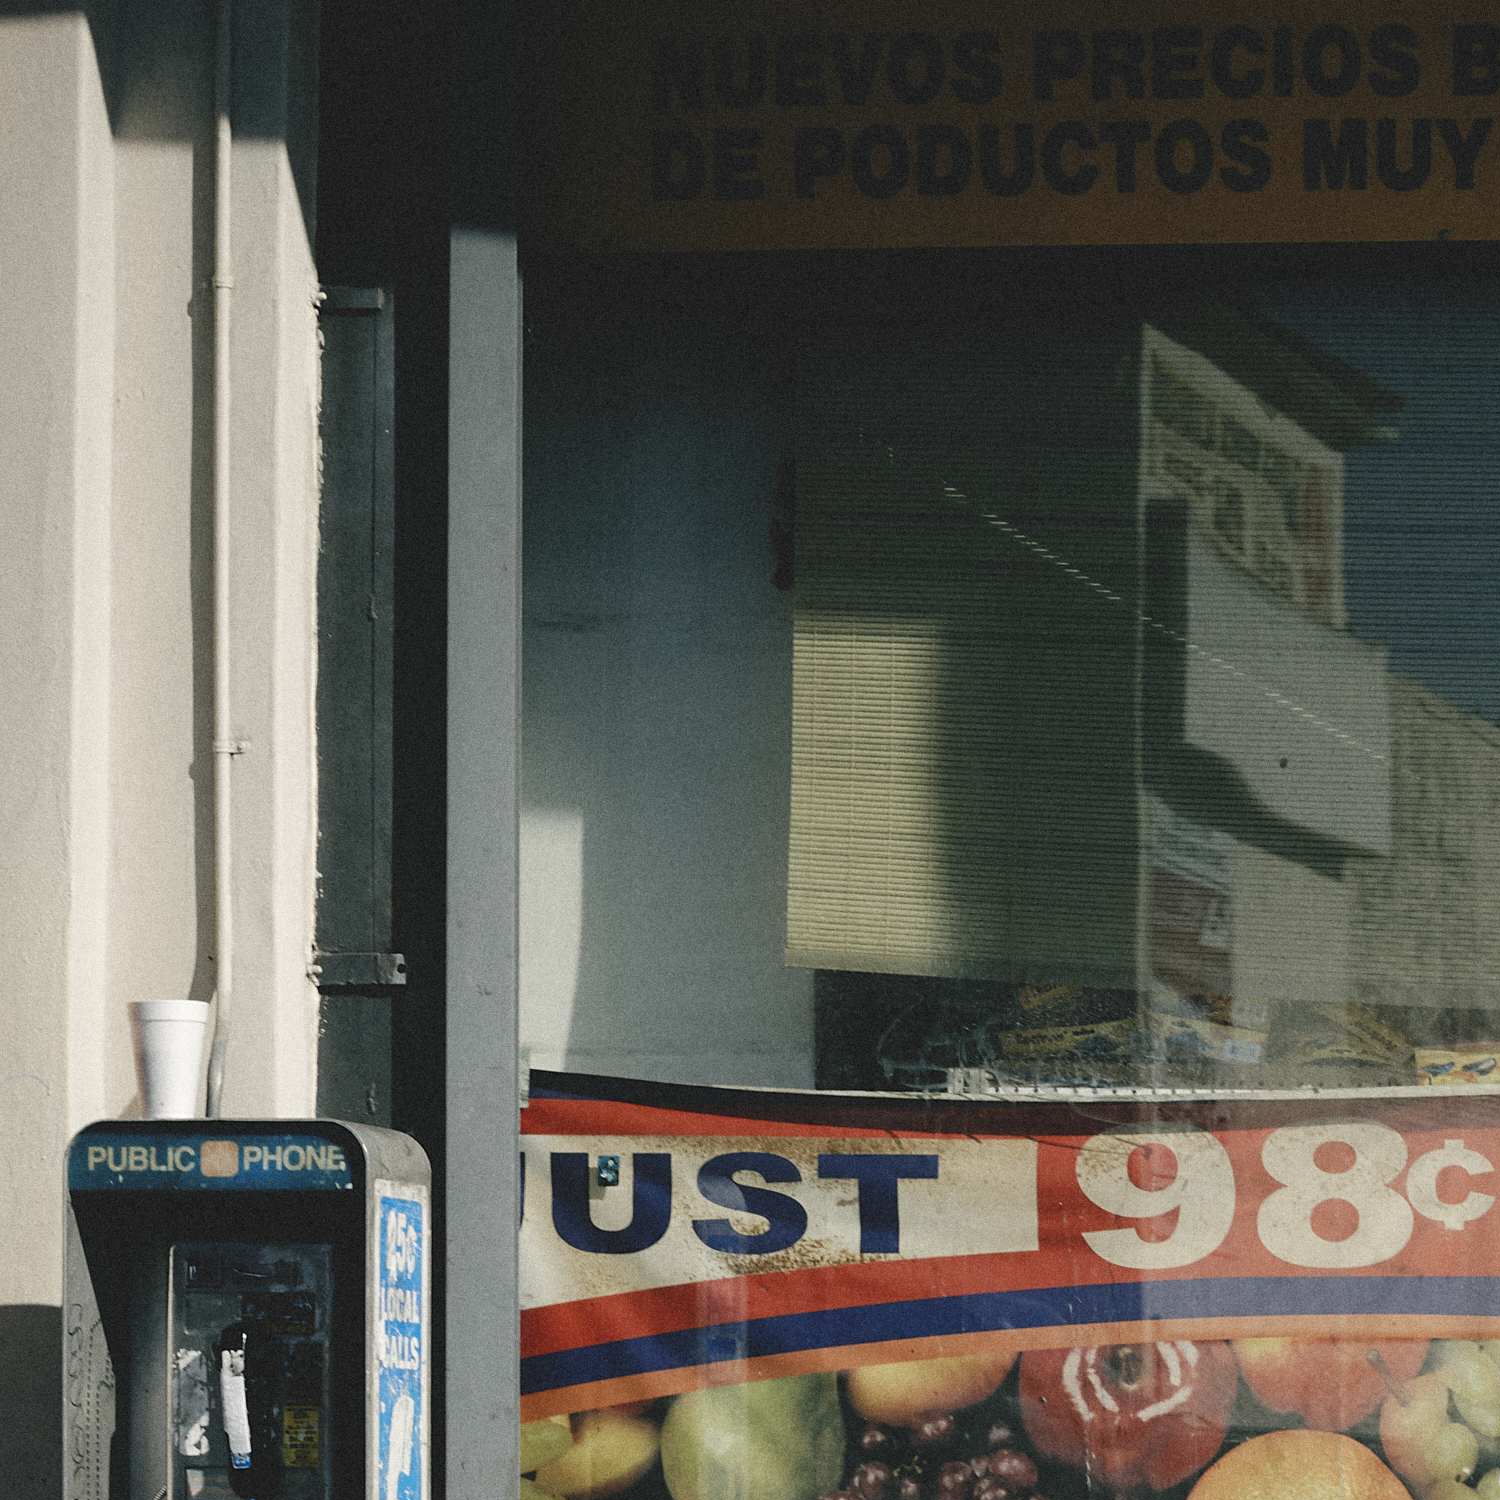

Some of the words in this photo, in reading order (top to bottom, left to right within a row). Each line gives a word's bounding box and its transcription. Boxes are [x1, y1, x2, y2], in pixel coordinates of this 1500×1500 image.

[651, 30, 999, 109] NUEVOS
[1034, 24, 1420, 101] PRECIOS
[651, 127, 765, 200] DE
[794, 118, 1272, 199] PODUCTOS
[1303, 117, 1493, 192] MUY
[87, 1145, 196, 1172] PUBLIC
[243, 1145, 346, 1172] PHONE
[520, 1152, 939, 1255] UST
[1074, 1118, 1496, 1269] 98¢
[380, 1286, 420, 1324] LOCAL
[380, 1335, 420, 1370] CALLS
